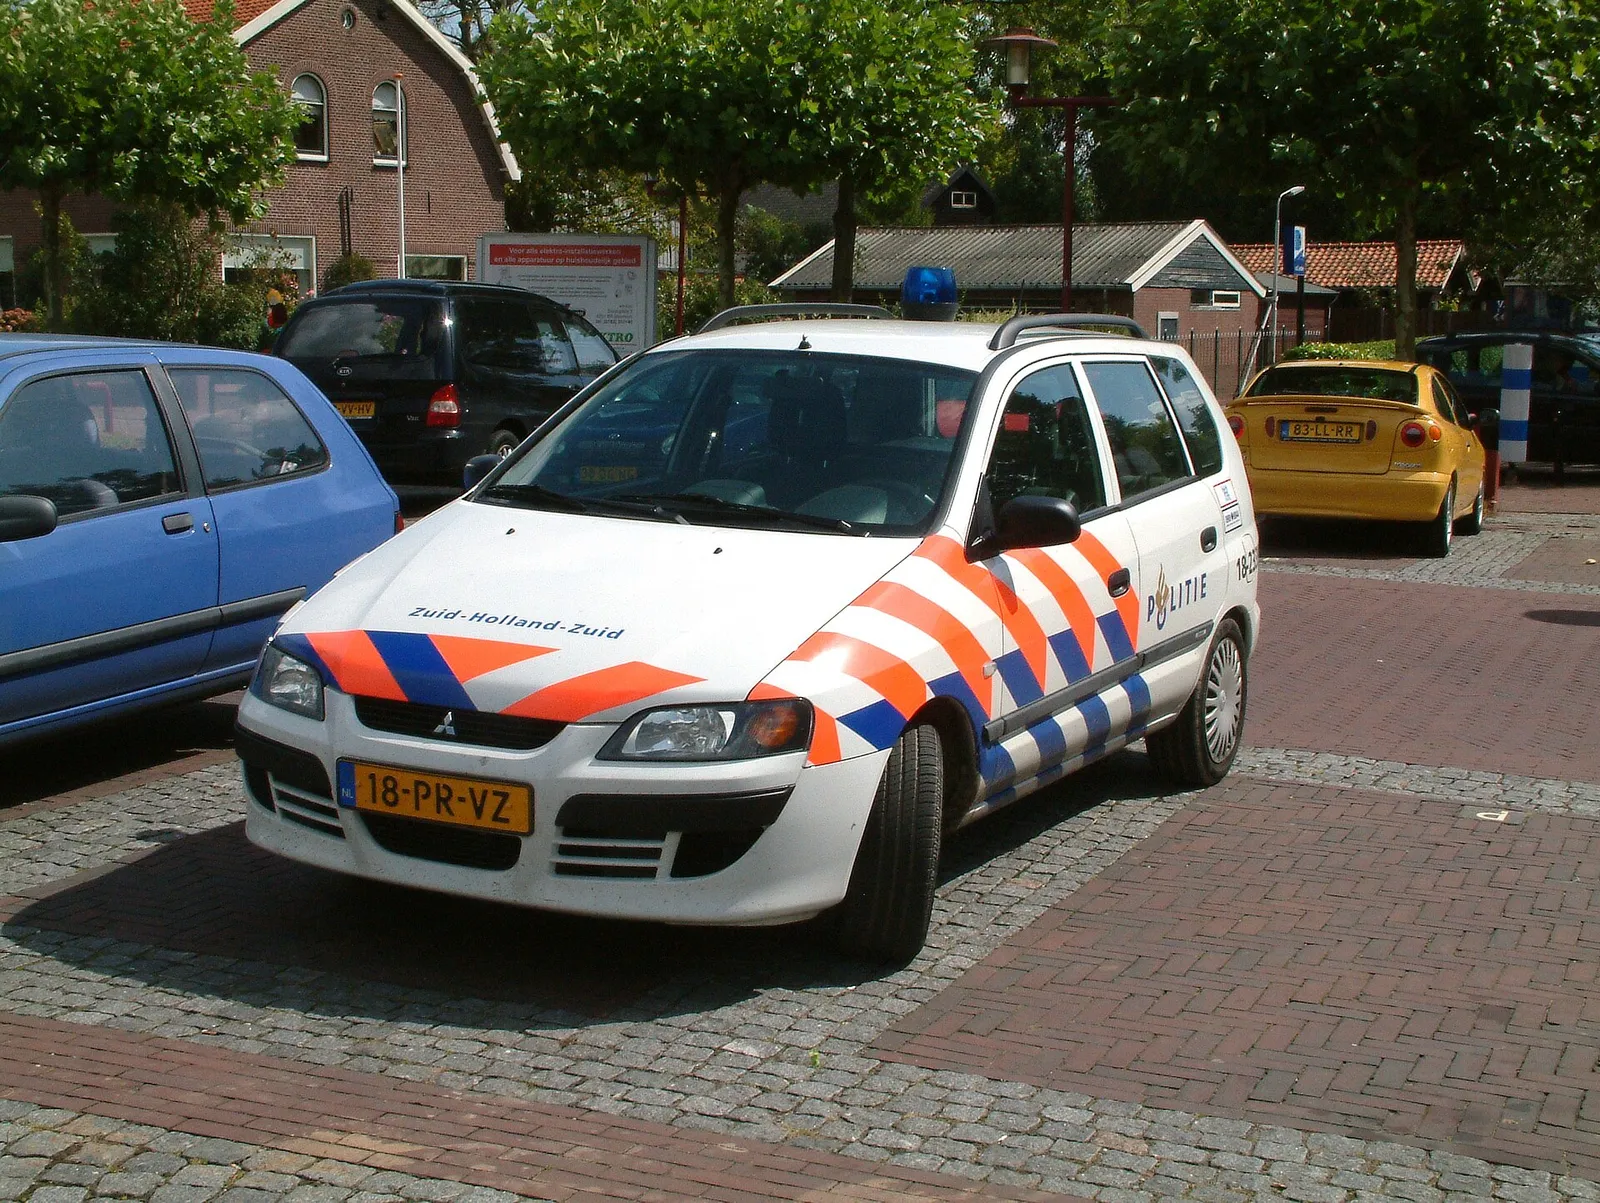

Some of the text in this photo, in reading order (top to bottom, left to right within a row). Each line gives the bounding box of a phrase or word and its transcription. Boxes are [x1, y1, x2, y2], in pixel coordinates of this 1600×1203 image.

[518, 257, 554, 265] apparatuur
[556, 257, 565, 265] op
[566, 256, 612, 265] huishoudelijk
[613, 257, 637, 265] gebied
[1293, 424, 1354, 438] 83-LL-RR
[1147, 572, 1207, 631] POLITIE
[408, 606, 624, 640] Zuid-Holland-Zuid
[341, 787, 354, 799] NL
[368, 772, 511, 824] 18-PR-VZ
